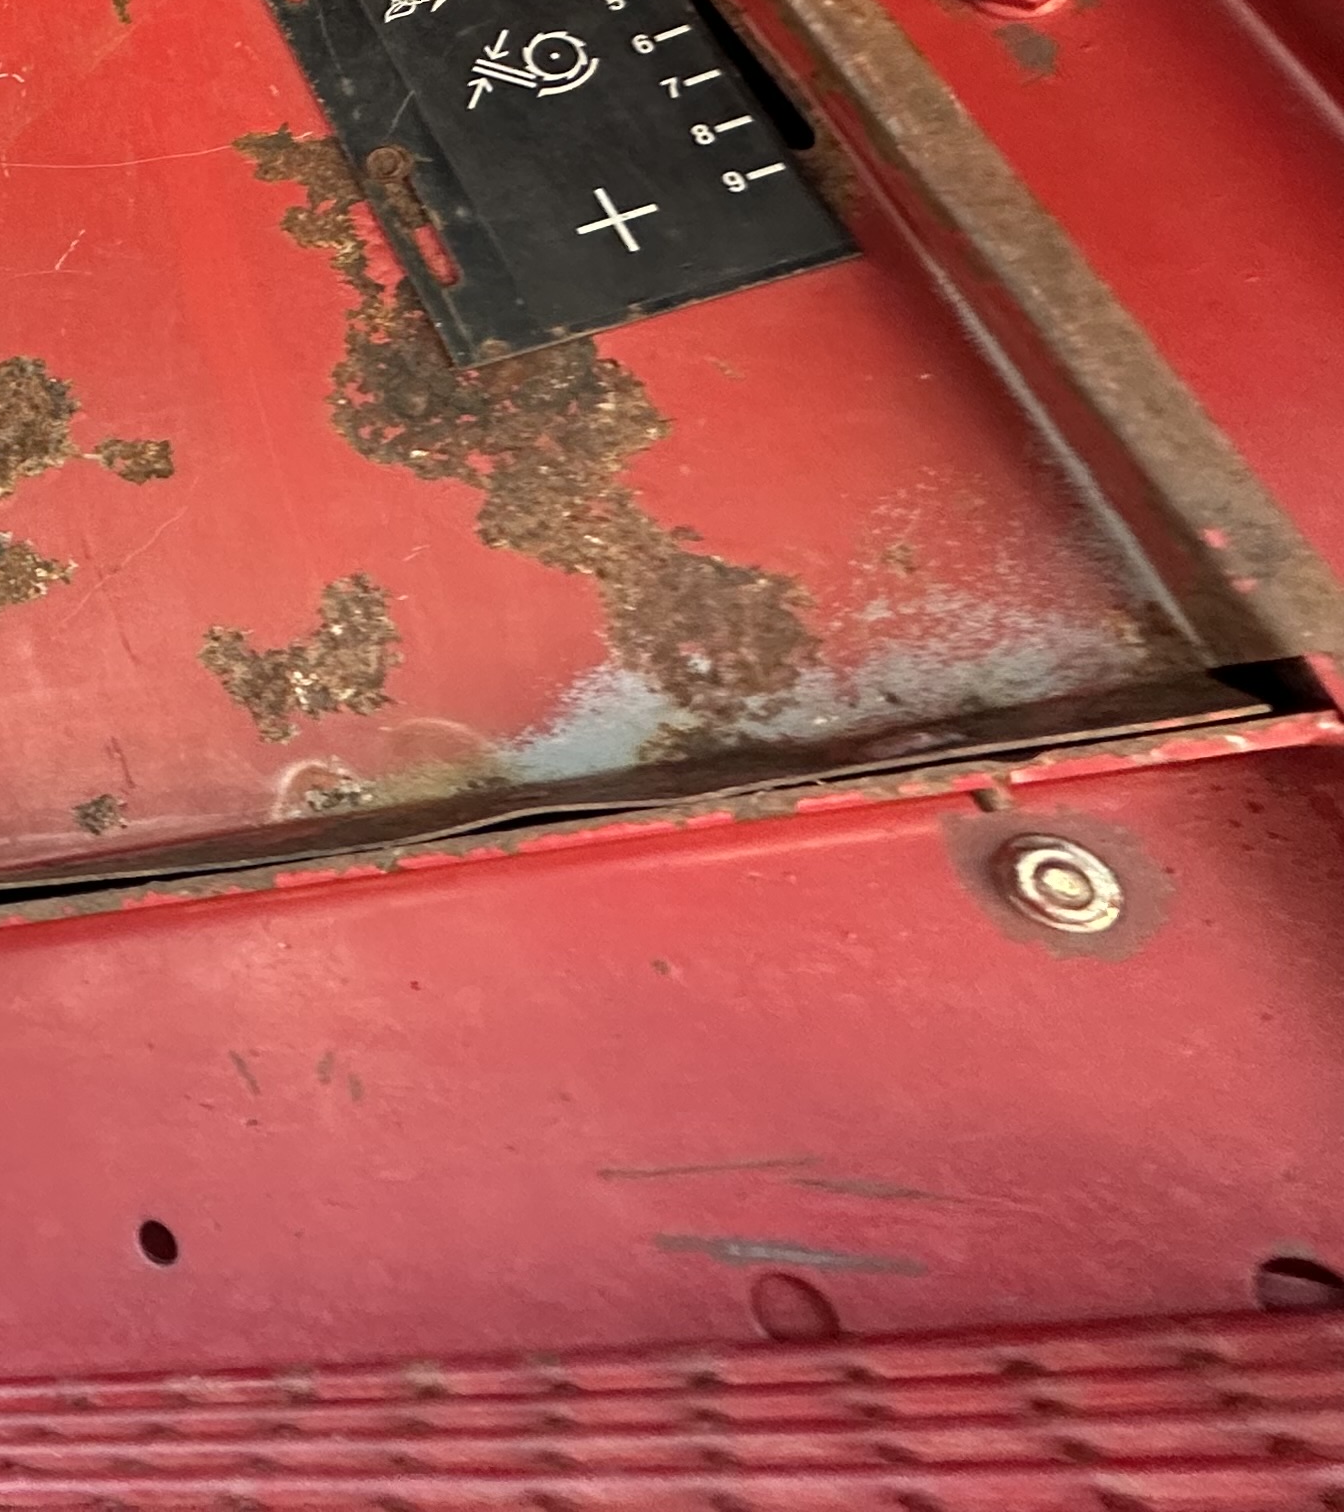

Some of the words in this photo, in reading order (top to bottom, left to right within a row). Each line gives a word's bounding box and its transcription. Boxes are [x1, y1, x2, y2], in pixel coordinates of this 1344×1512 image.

[631, 34, 655, 54] 6
[659, 76, 680, 99] 7
[690, 124, 716, 145] 8
[722, 171, 748, 193] 9
